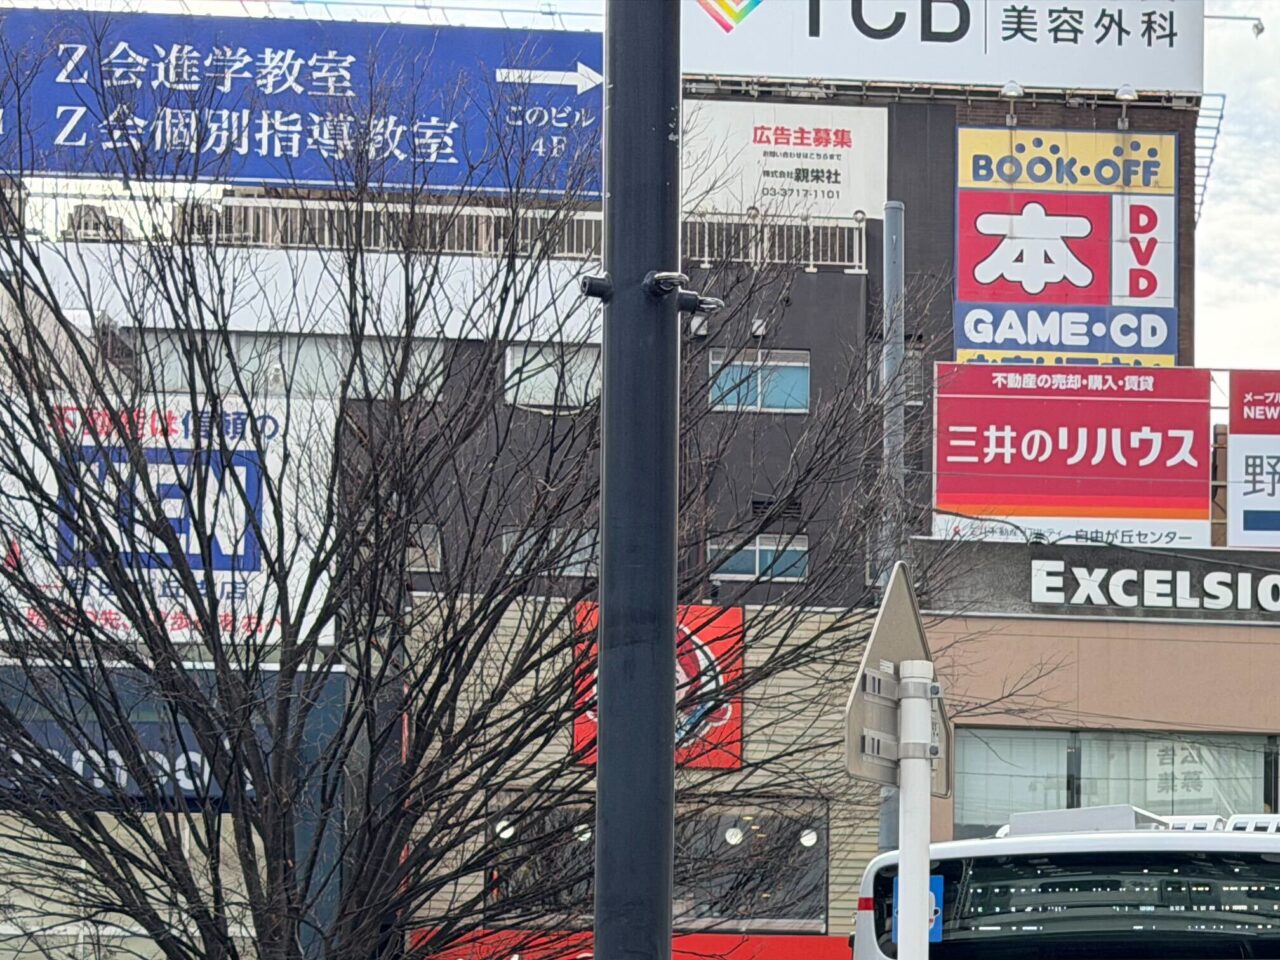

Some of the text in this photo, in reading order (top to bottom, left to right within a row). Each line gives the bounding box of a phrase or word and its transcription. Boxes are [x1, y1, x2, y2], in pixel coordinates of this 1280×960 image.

[1001, 8, 1178, 49] 美容外科
[55, 41, 356, 98] Z会進学教室
[54, 105, 459, 164] Z会個別指導教室
[505, 104, 595, 126] このビル
[531, 136, 566, 157] 4F
[752, 125, 852, 148] 広告主募集
[974, 201, 1095, 295] 本
[1128, 203, 1158, 298] DVD
[946, 425, 1199, 469] 三井のリハウス
[1075, 529, 1193, 545] 自由が丘センター
